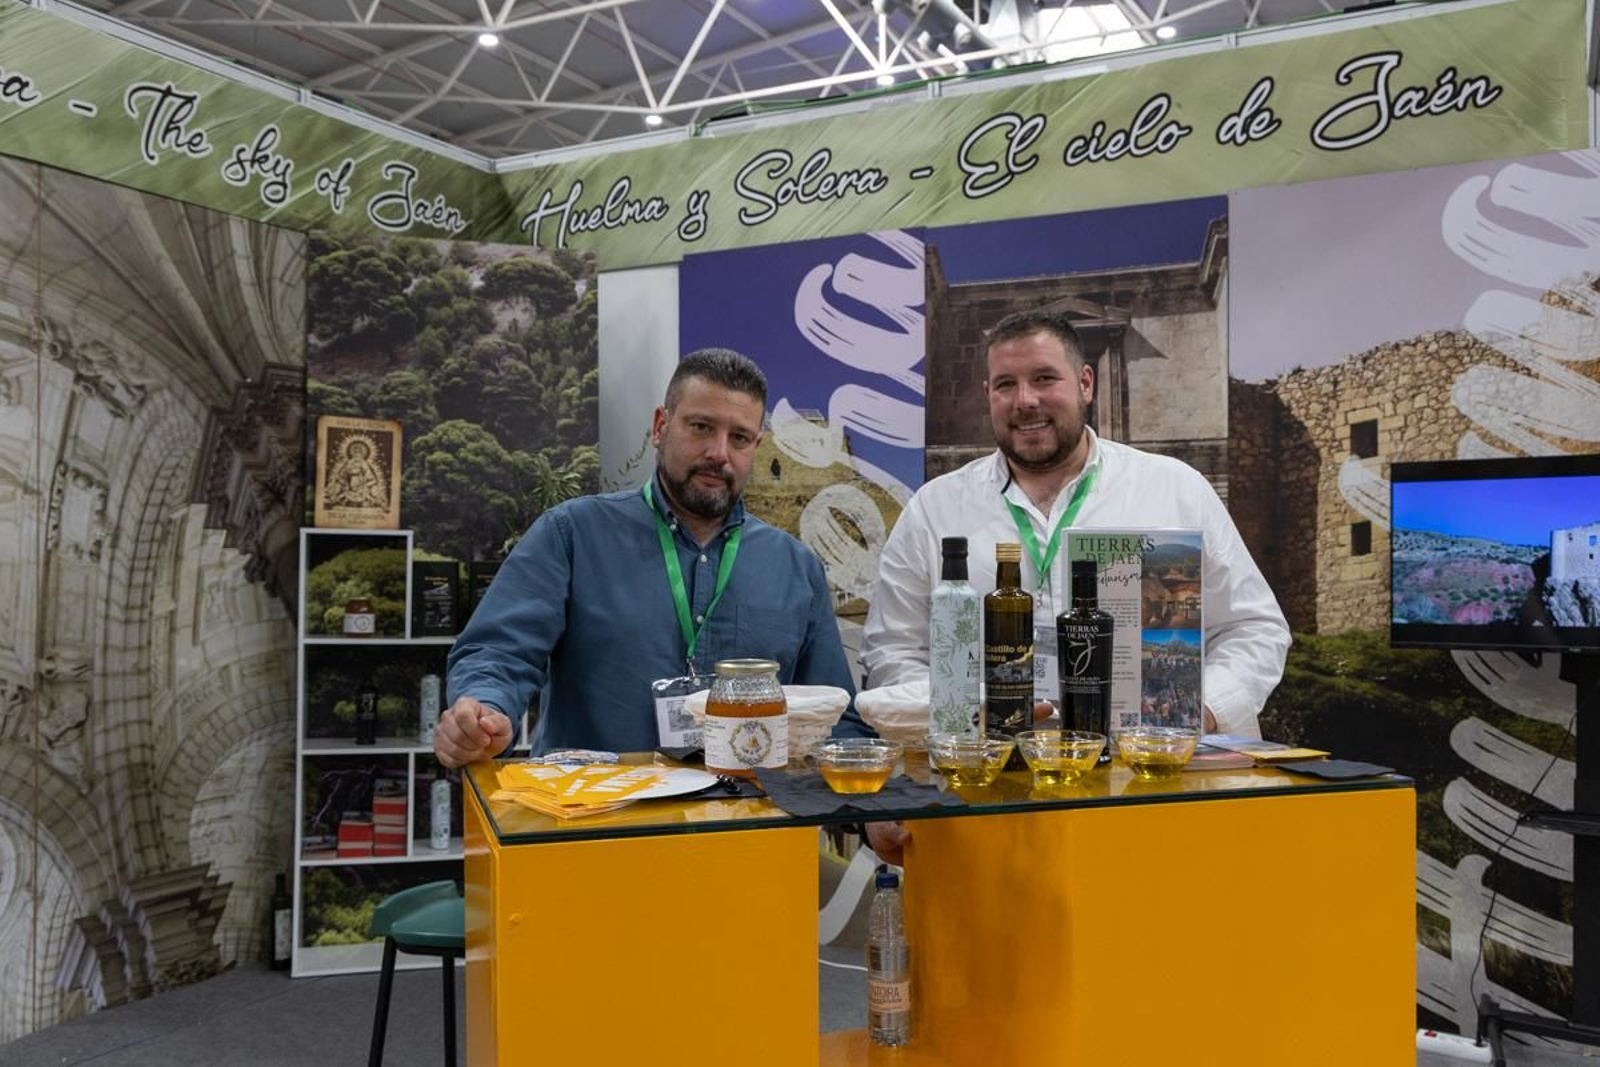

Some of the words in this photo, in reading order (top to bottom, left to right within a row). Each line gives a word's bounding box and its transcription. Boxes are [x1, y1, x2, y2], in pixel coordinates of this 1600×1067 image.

[127, 84, 210, 161] The
[222, 126, 292, 204] sky
[316, 160, 353, 211] of
[369, 163, 466, 228] Jaén
[519, 177, 670, 250] Huelma
[678, 190, 709, 241] y
[734, 149, 889, 225] Solera
[958, 111, 1047, 199] El
[1063, 92, 1193, 166] cielo
[1215, 75, 1283, 147] de
[1310, 50, 1504, 151] Jaén
[1076, 537, 1156, 552] TIERRAS
[1065, 624, 1099, 633] TIERRAS
[1016, 644, 1028, 653] de
